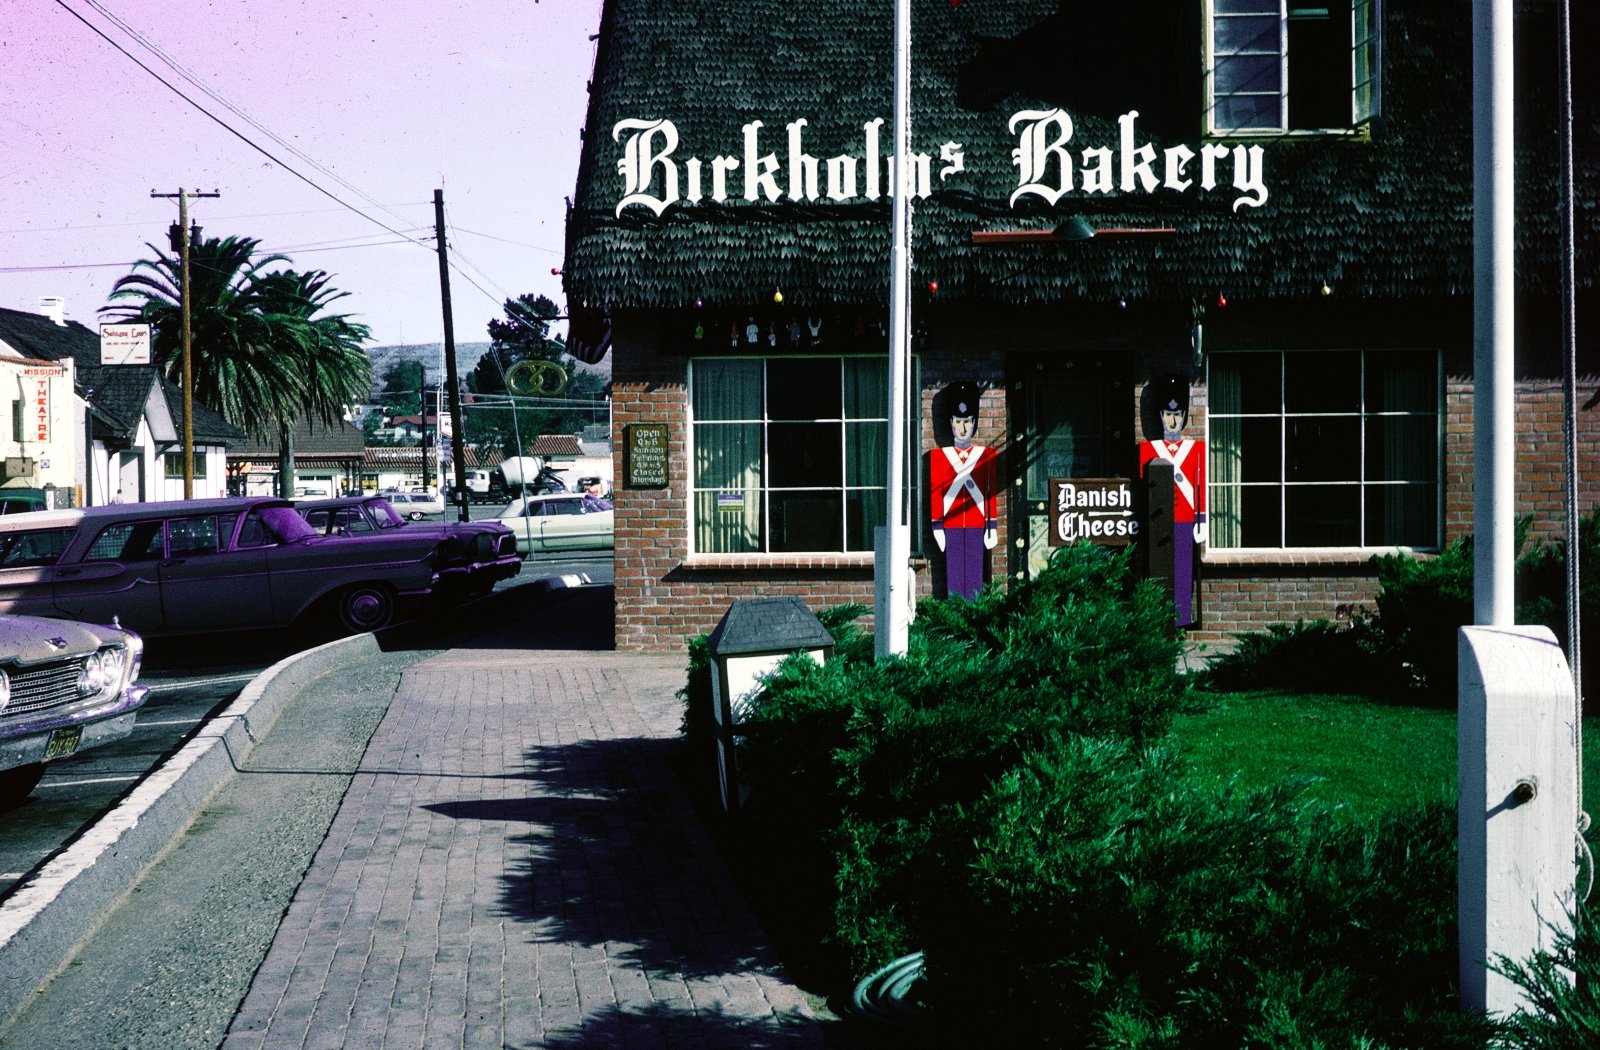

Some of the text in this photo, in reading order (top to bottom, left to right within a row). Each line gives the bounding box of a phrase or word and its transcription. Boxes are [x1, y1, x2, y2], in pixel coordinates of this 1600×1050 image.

[1008, 107, 1269, 213] Bakery
[24, 368, 61, 376] MISSION
[37, 380, 47, 441] THEATRE
[636, 429, 660, 438] Open
[633, 468, 664, 477] Closed
[1058, 483, 1131, 511] Danish
[1058, 512, 1139, 542] Cheese
